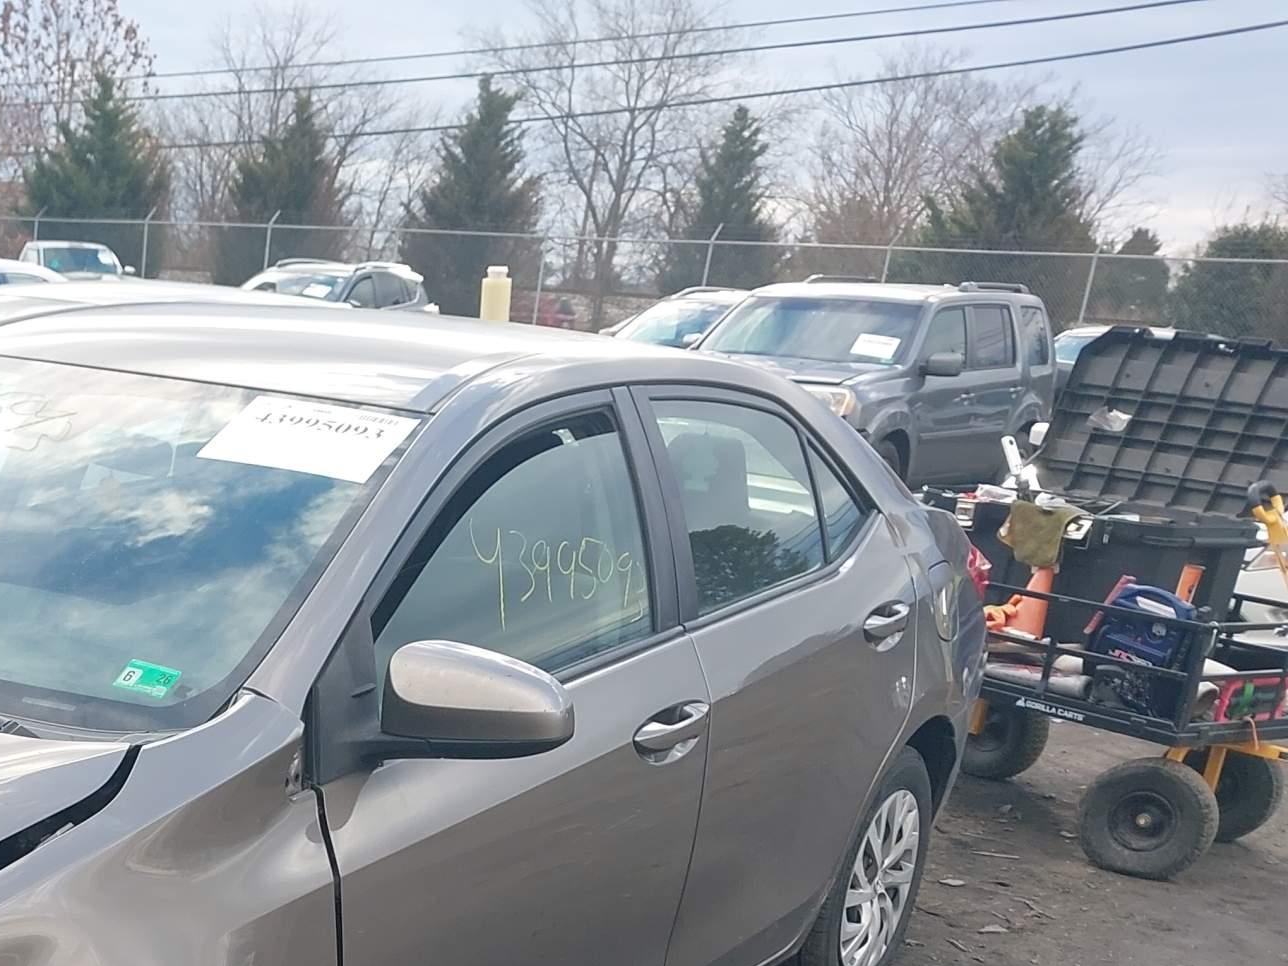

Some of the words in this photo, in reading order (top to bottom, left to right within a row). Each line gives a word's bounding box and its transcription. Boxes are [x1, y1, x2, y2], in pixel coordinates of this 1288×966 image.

[255, 411, 386, 440] 43995093
[122, 670, 136, 682] 6
[1025, 699, 1057, 715] GORILLA
